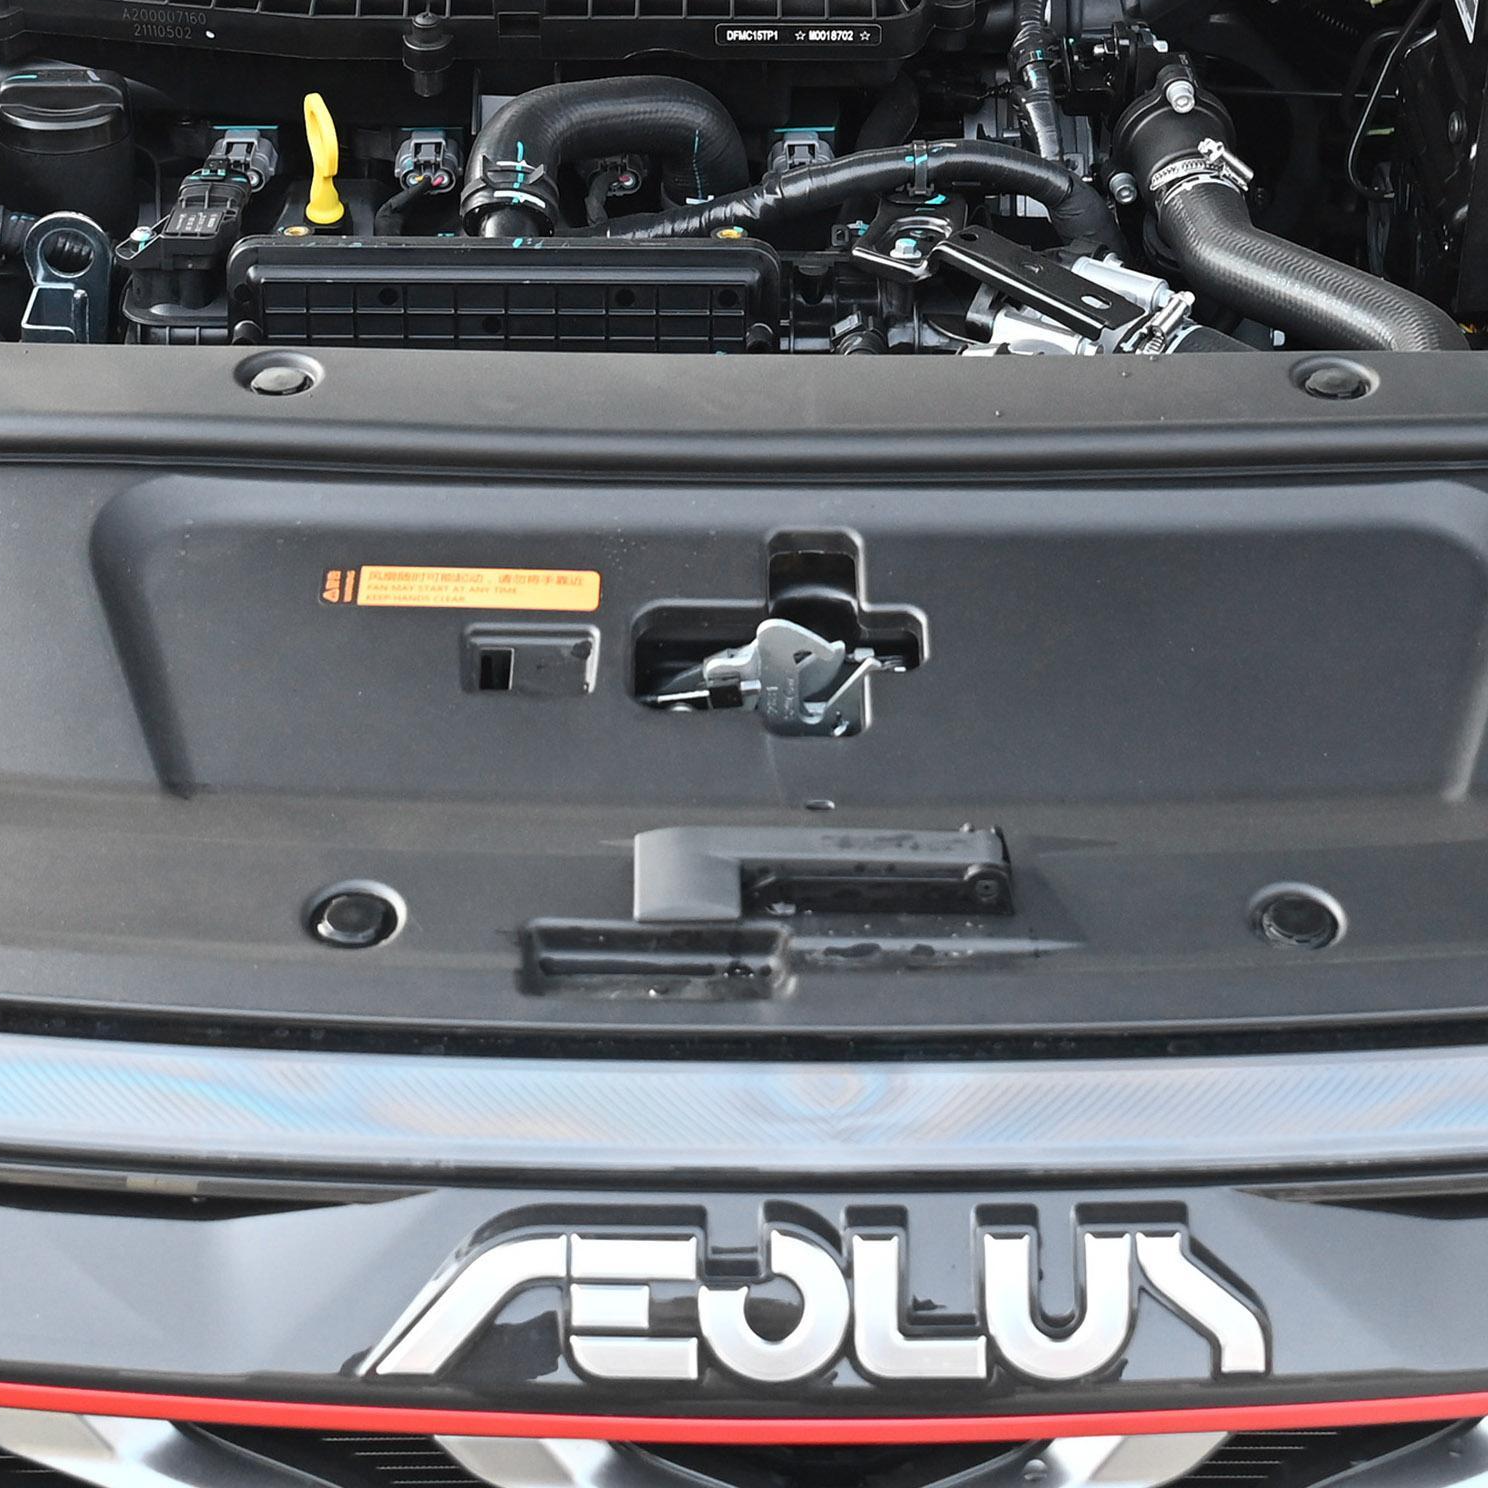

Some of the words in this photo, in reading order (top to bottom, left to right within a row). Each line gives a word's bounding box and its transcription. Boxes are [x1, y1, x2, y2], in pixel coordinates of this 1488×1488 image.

[121, 7, 207, 25] A200007160
[134, 23, 192, 39] 21110502
[726, 30, 779, 41] DFMC15TP1
